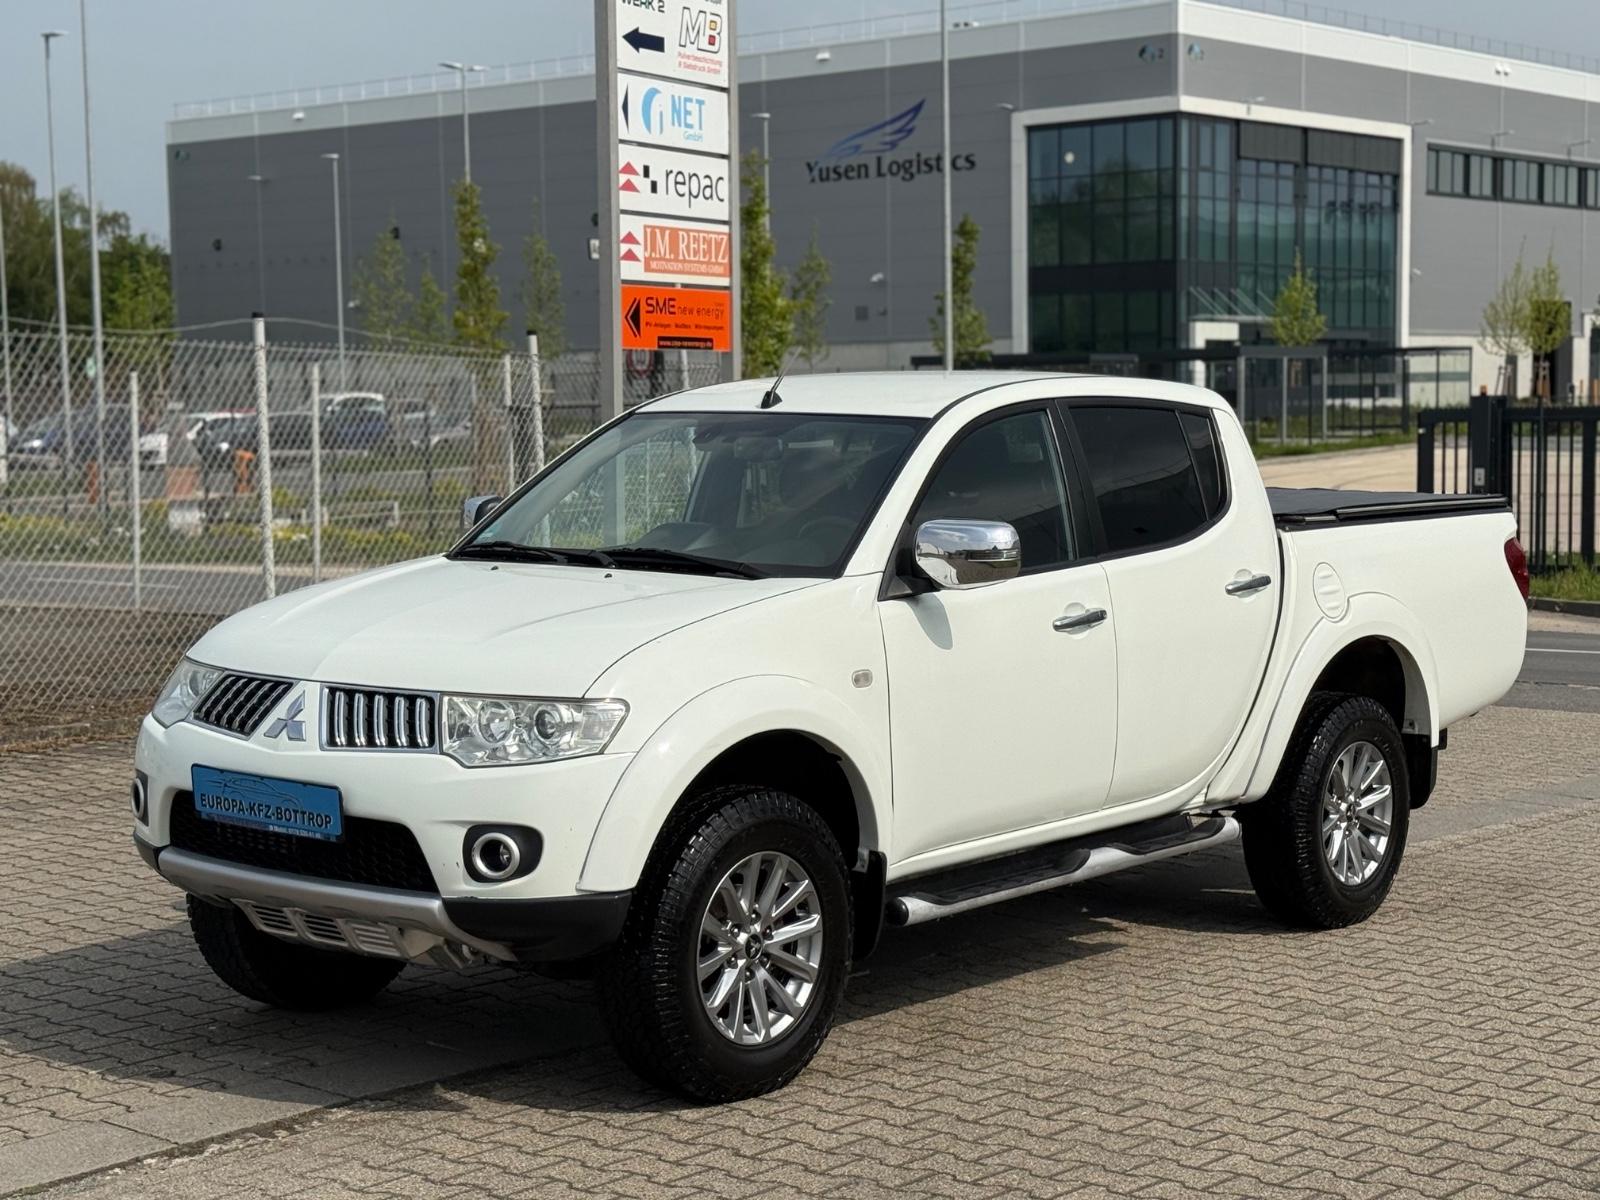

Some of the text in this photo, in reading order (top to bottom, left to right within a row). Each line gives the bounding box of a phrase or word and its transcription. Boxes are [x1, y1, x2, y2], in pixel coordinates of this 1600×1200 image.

[657, 0, 665, 14] 2
[679, 6, 723, 54] MB
[671, 94, 705, 131] NET
[805, 152, 977, 184] Yusen Logistcs
[665, 167, 725, 208] repac
[644, 228, 729, 263] J.M. REETZ
[645, 296, 724, 321] SME new energy
[200, 793, 332, 830] EUROPA-KFZ-BOTTROP
